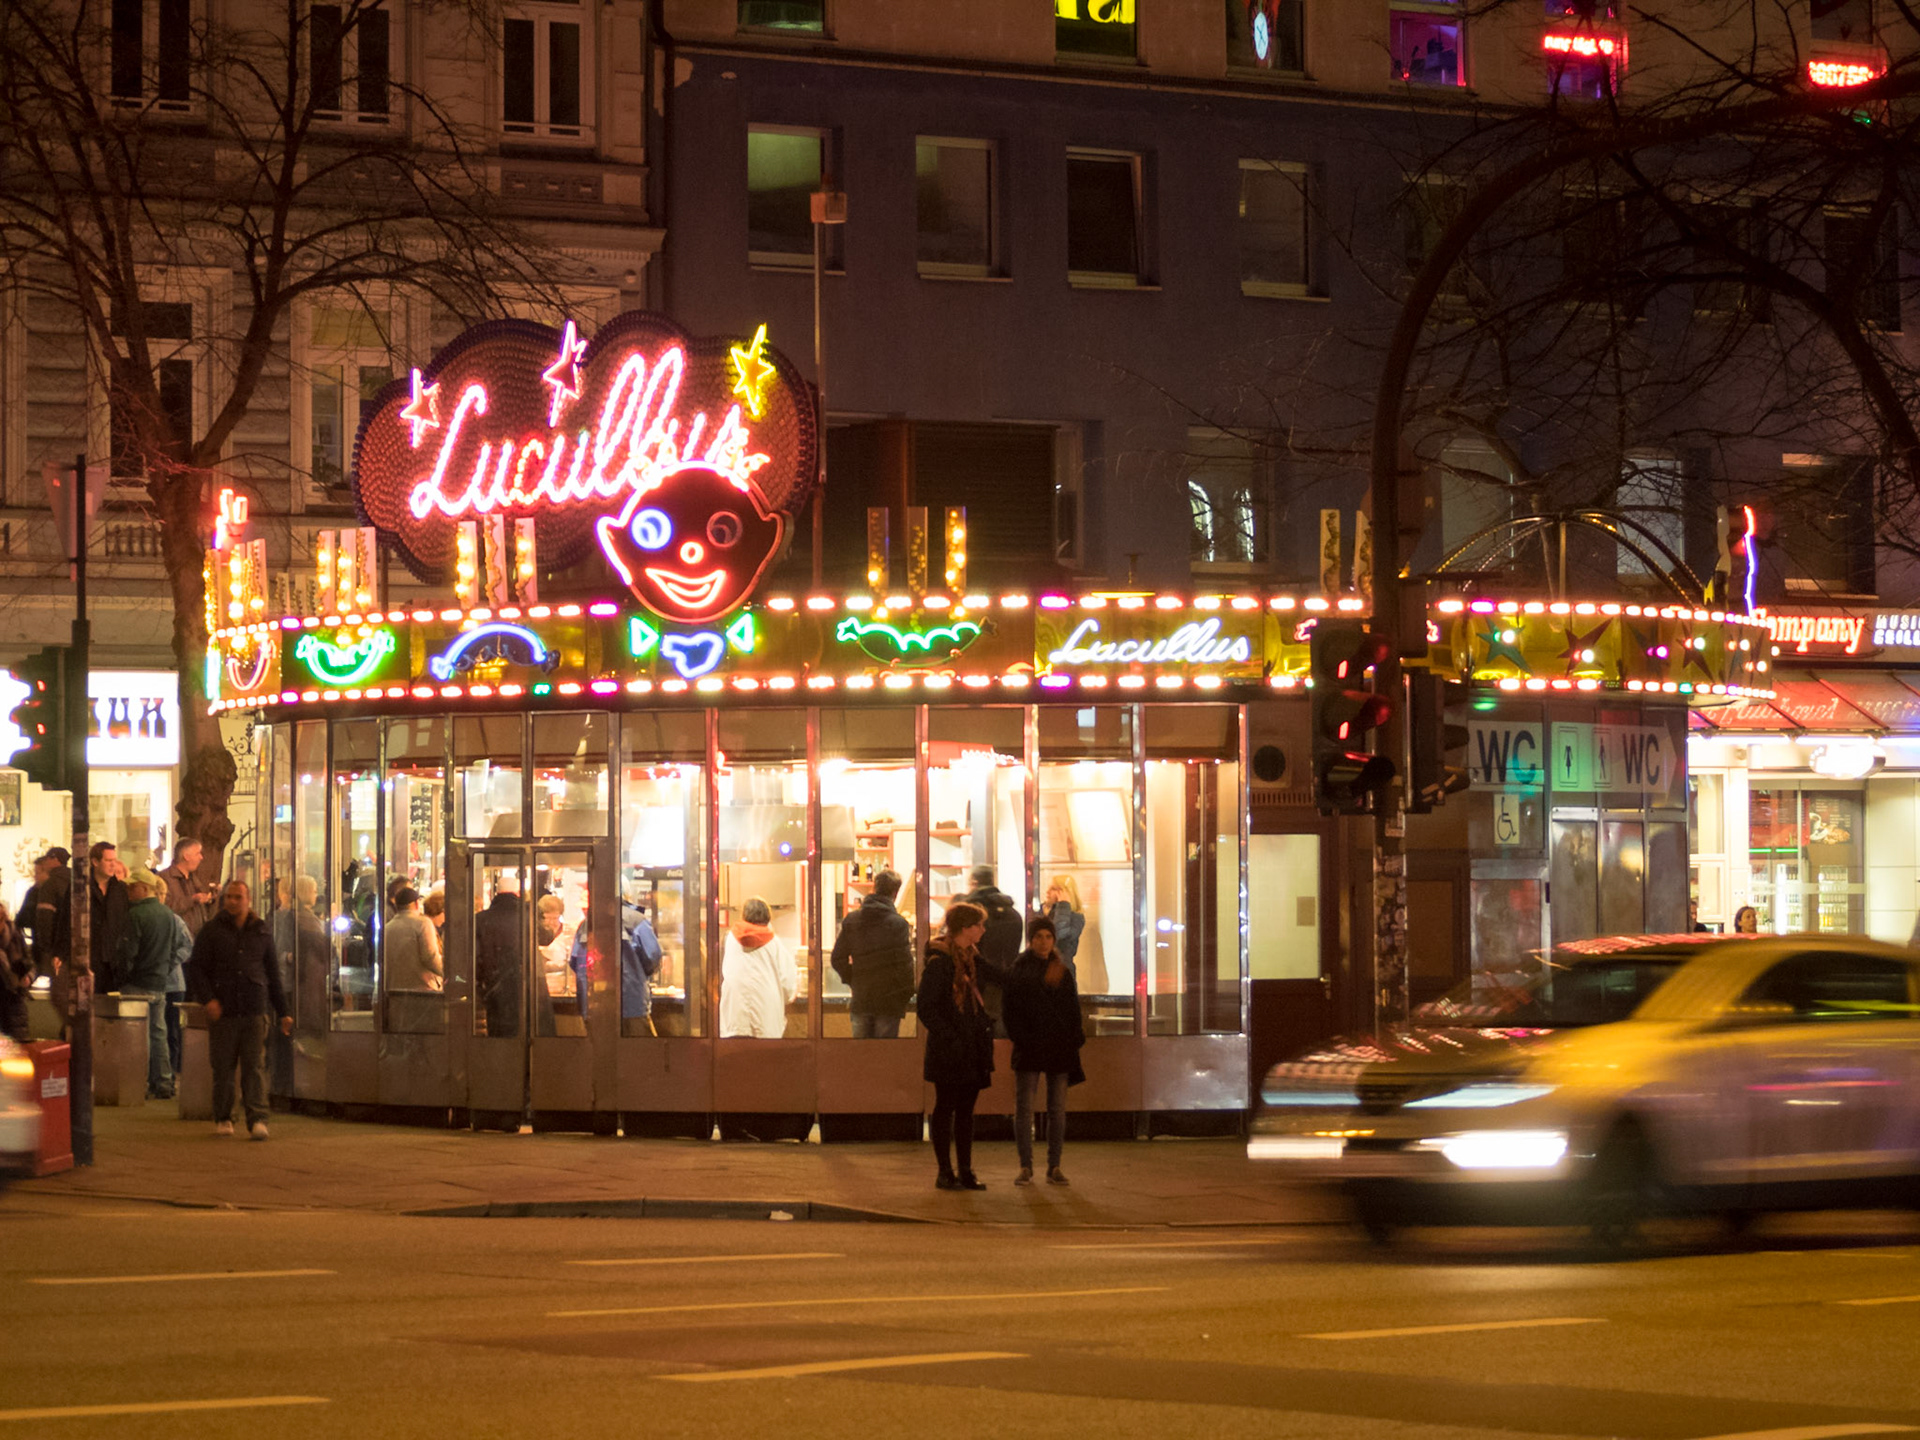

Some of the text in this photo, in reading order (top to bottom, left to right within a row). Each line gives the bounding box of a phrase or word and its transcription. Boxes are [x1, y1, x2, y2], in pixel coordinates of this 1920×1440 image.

[408, 347, 757, 518] Lucullus
[1049, 617, 1250, 663] Lucullus
[1875, 614, 1920, 630] MUSI
[1477, 729, 1536, 784] WC
[1623, 733, 1660, 785] WC
